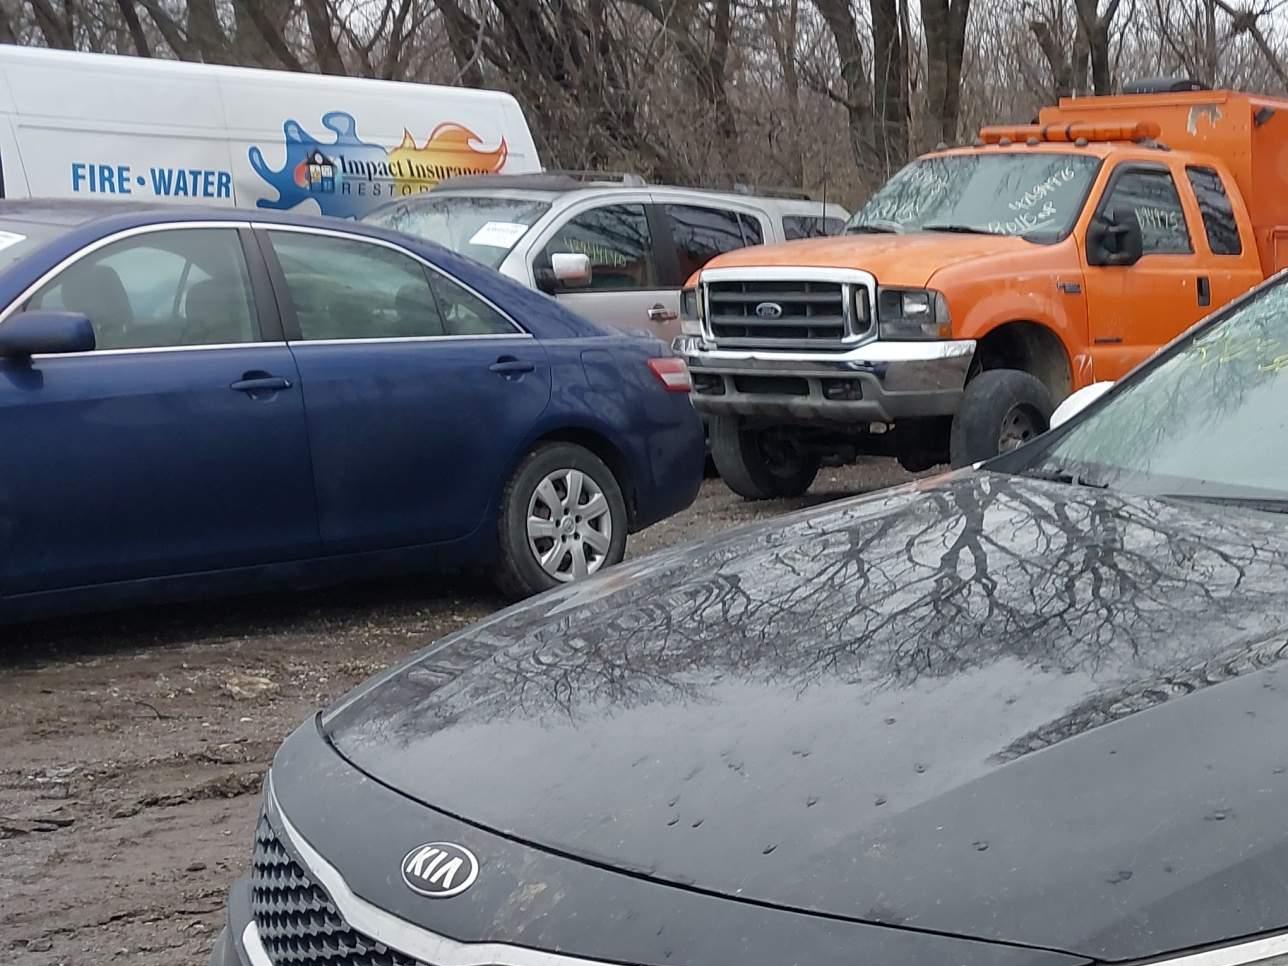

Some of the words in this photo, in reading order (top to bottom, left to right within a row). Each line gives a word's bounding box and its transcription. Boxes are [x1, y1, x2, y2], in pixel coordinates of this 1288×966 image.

[71, 162, 132, 194] FIRE
[150, 167, 231, 198] WATER
[339, 154, 404, 181] Impact
[405, 846, 464, 889] KIA
